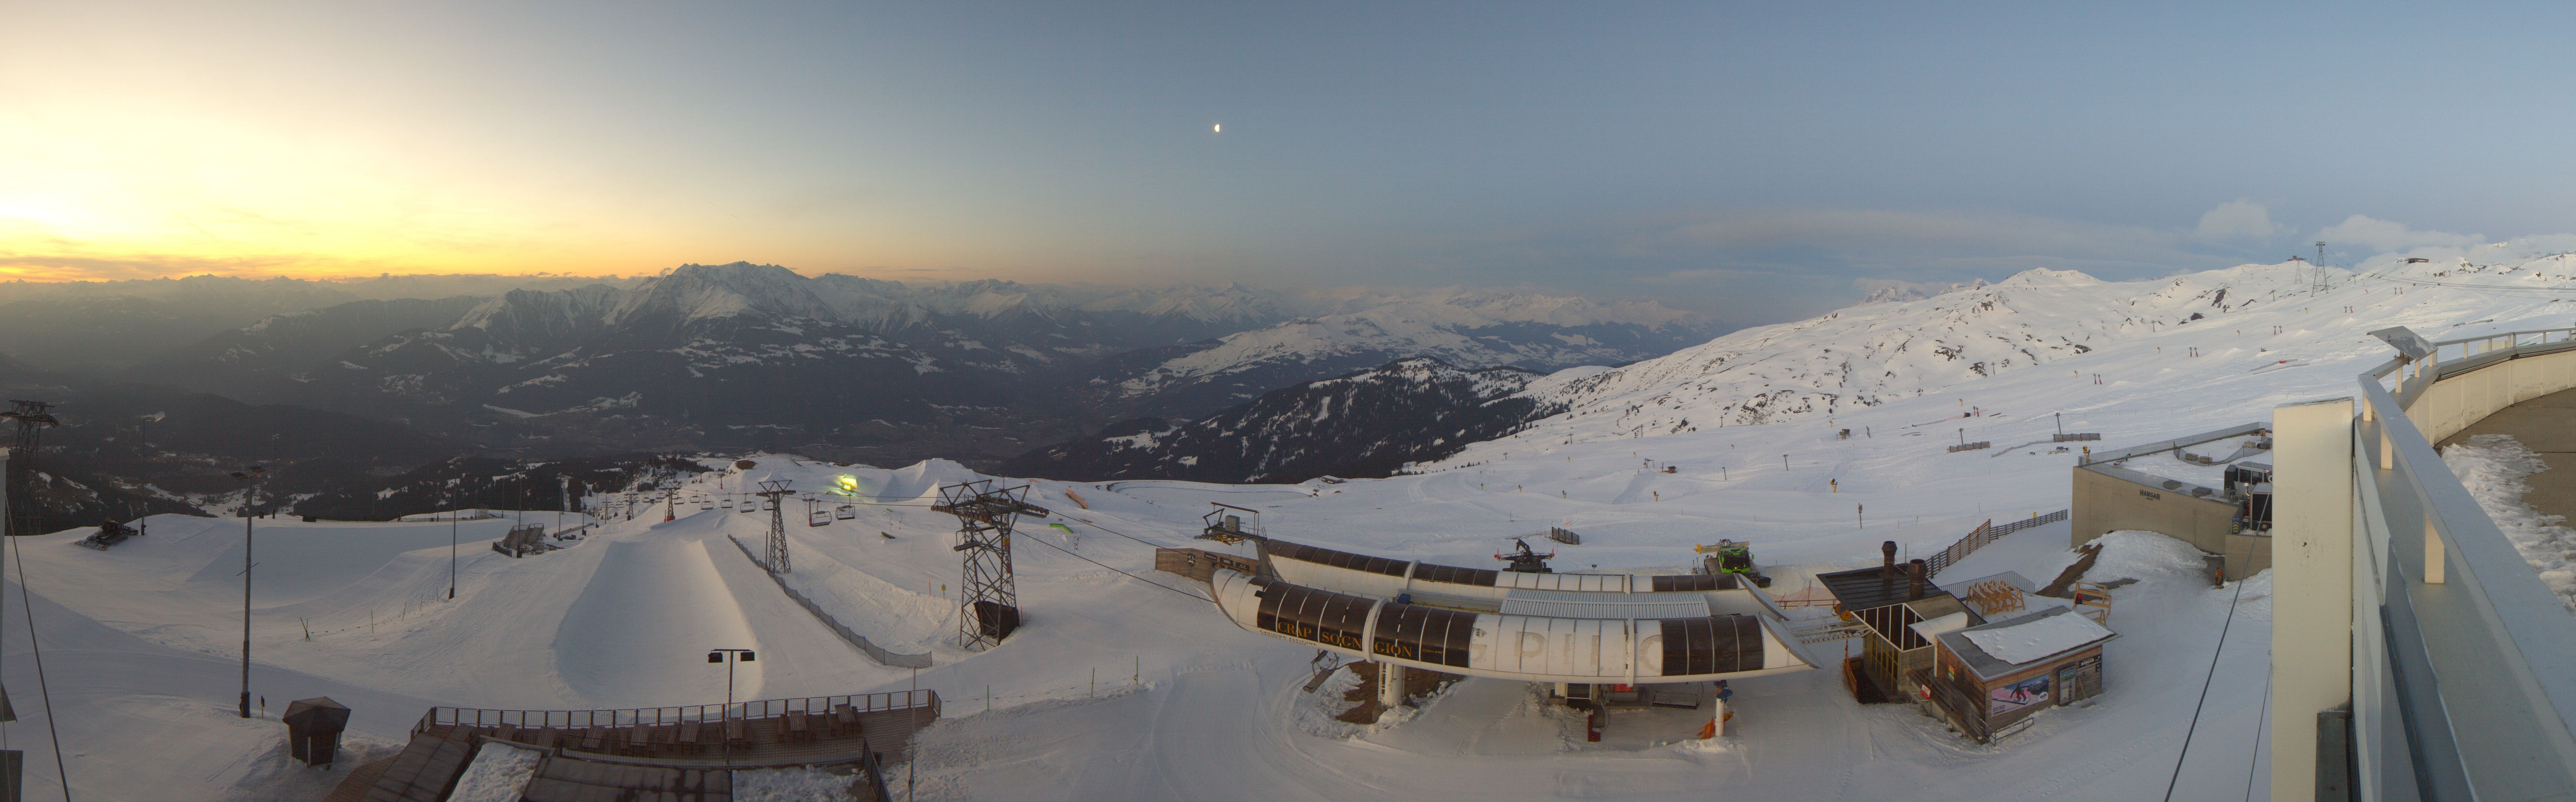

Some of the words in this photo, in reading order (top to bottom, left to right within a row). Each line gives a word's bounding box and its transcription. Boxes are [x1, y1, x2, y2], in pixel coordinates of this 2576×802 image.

[2140, 489, 2160, 500] HANGAR
[1260, 630, 1286, 639] CRUISING
[1289, 637, 1317, 646] ALTITUDE
[1278, 622, 1312, 638] CRAP
[1322, 632, 1362, 649] SOGN
[1374, 641, 1412, 657] GION
